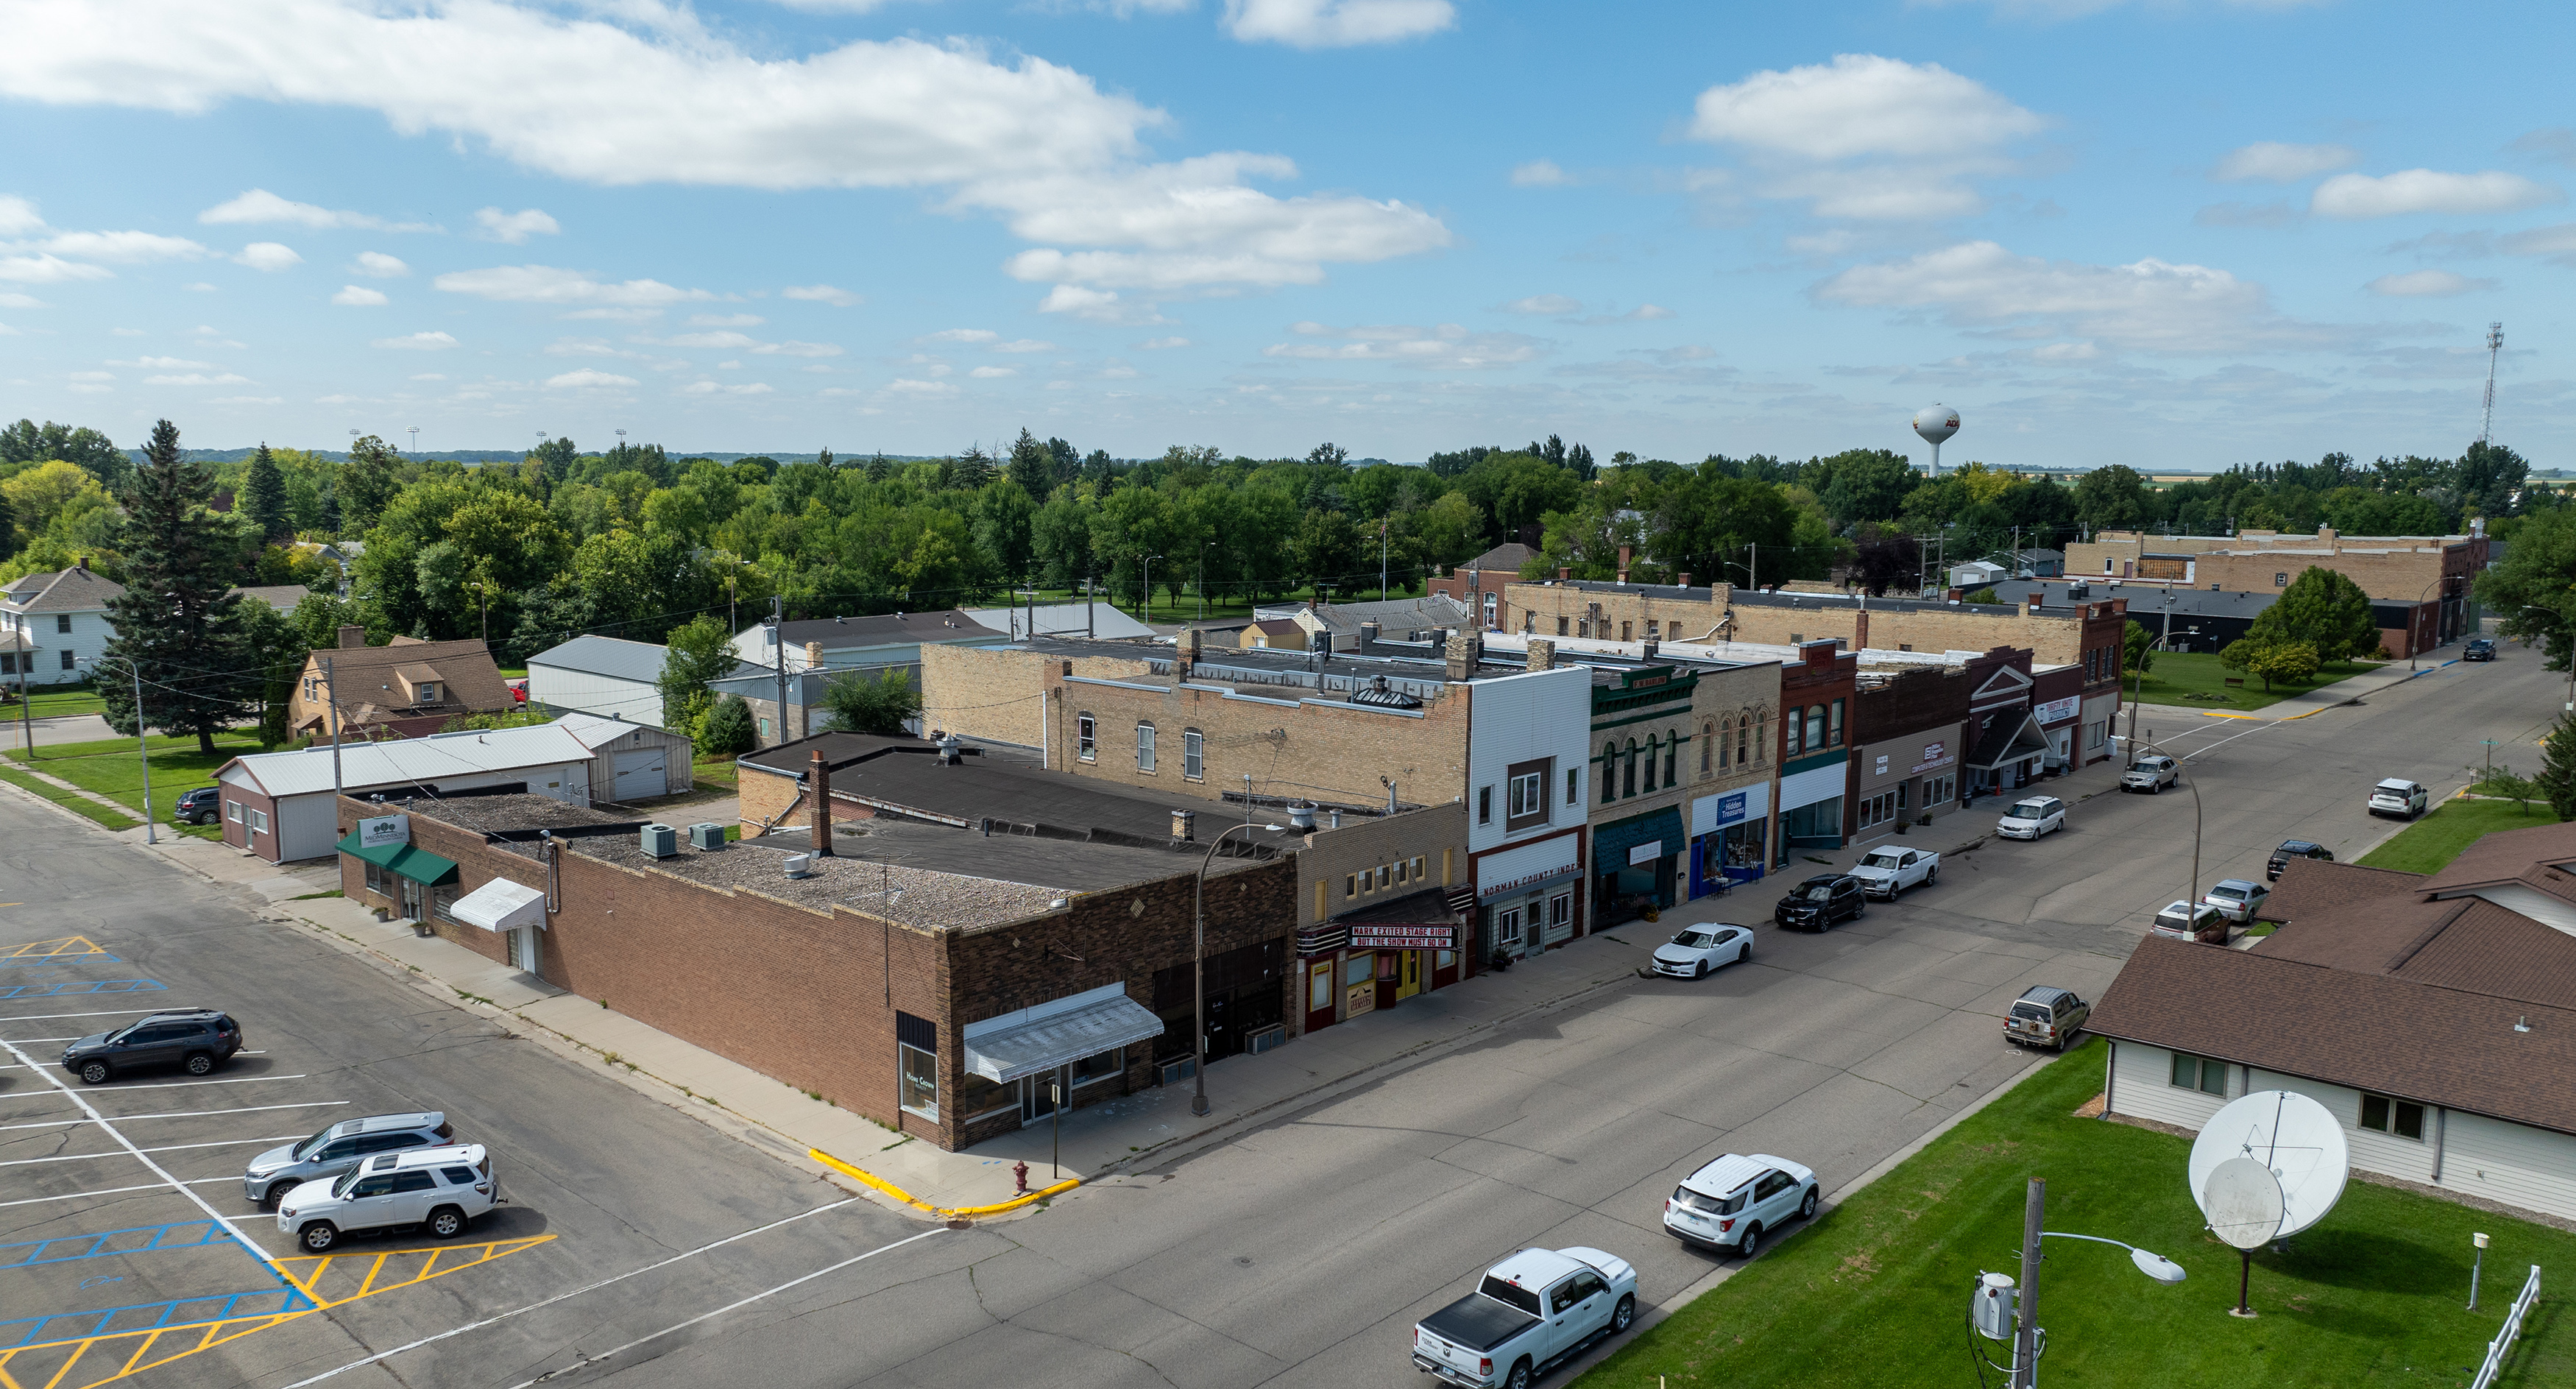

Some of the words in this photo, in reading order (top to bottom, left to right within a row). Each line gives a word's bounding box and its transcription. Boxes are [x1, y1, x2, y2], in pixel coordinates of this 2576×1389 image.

[2046, 701, 2061, 712] THRIFTY
[2062, 699, 2073, 707] WHITE
[2049, 707, 2070, 721] PHARMACY
[1726, 801, 1741, 810] Hidden
[1722, 807, 1744, 818] Treasures
[1484, 879, 1518, 897] NORMAN
[1522, 869, 1554, 885] COUNTY
[1557, 862, 1580, 875] INDEX
[1378, 927, 1404, 936] EXITED
[1406, 927, 1427, 936] STAGE
[1430, 928, 1451, 936] RIGHT
